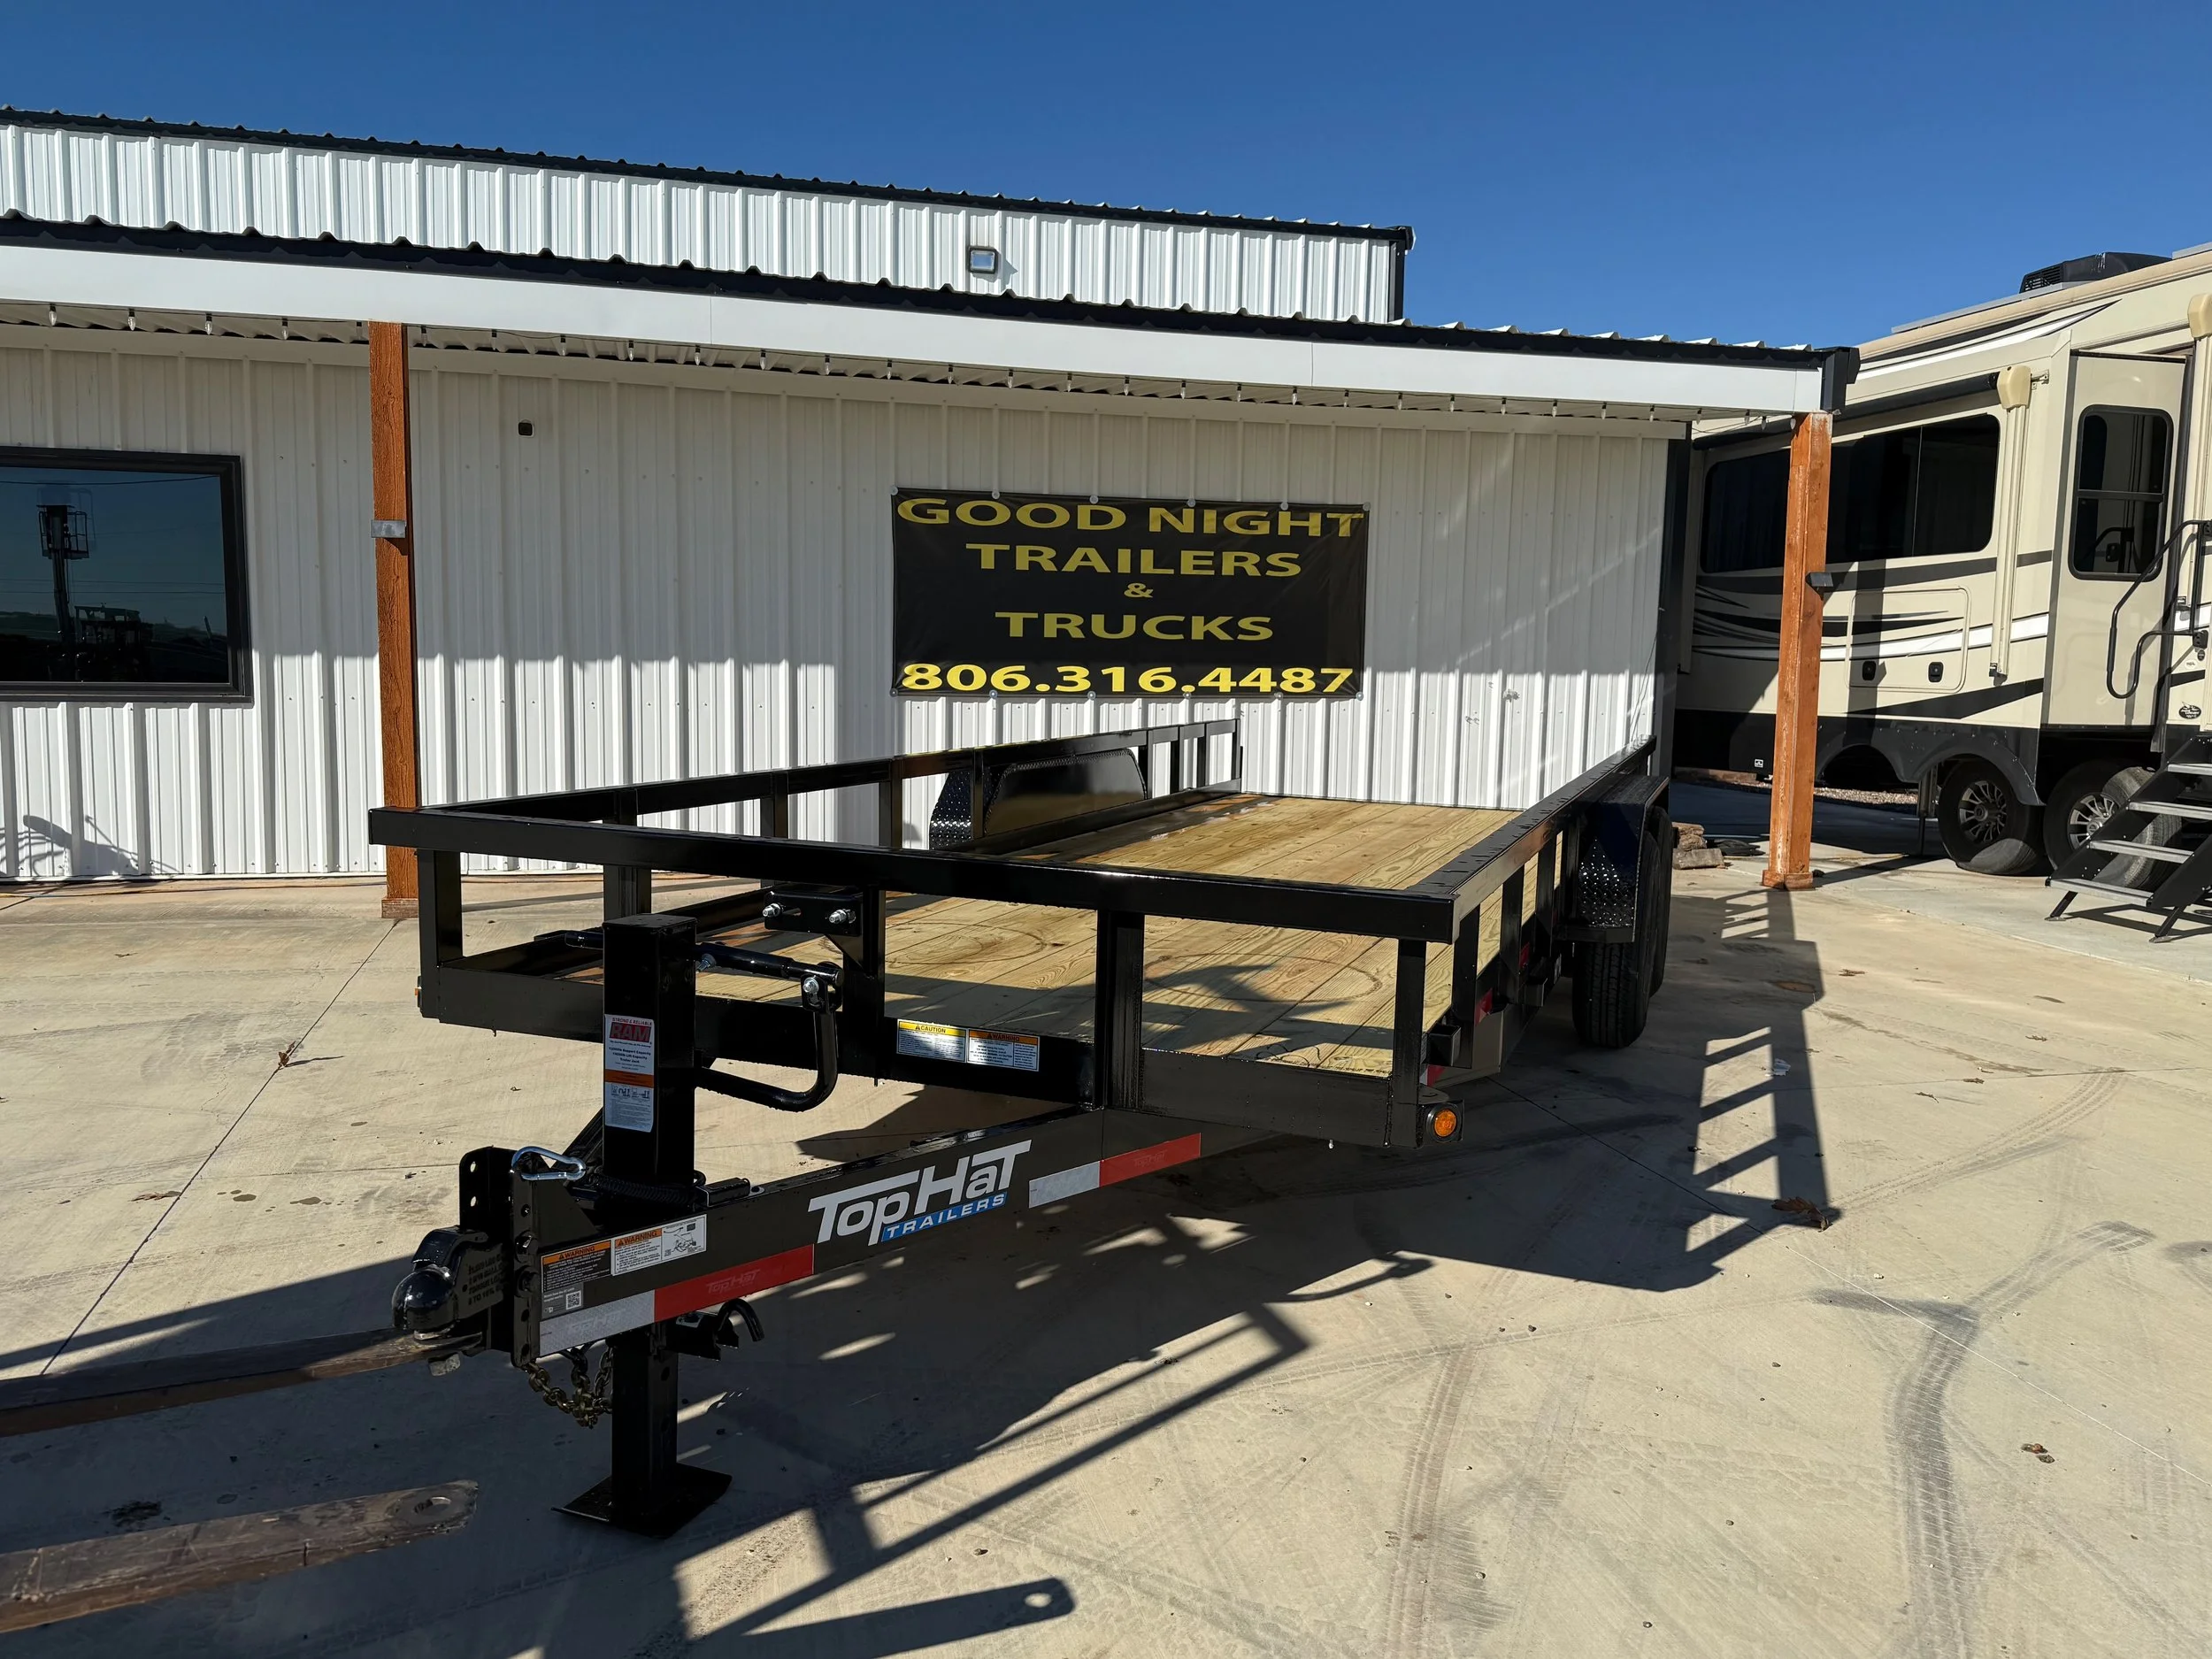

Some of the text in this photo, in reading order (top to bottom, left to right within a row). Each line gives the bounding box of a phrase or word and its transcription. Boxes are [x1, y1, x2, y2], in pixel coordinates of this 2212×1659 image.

[897, 498, 1364, 538] GOOD NIGHT
[965, 542, 1302, 577] TRAILERS
[1124, 582, 1154, 598] &
[995, 611, 1273, 641] TRUCKS
[901, 663, 1354, 693] 806.316.4487
[611, 1023, 651, 1042] RAM
[991, 1033, 1020, 1042] WARNING
[887, 1194, 1005, 1239] TRAILERS
[624, 1231, 657, 1244] WARNING
[565, 1246, 595, 1257] WARNING
